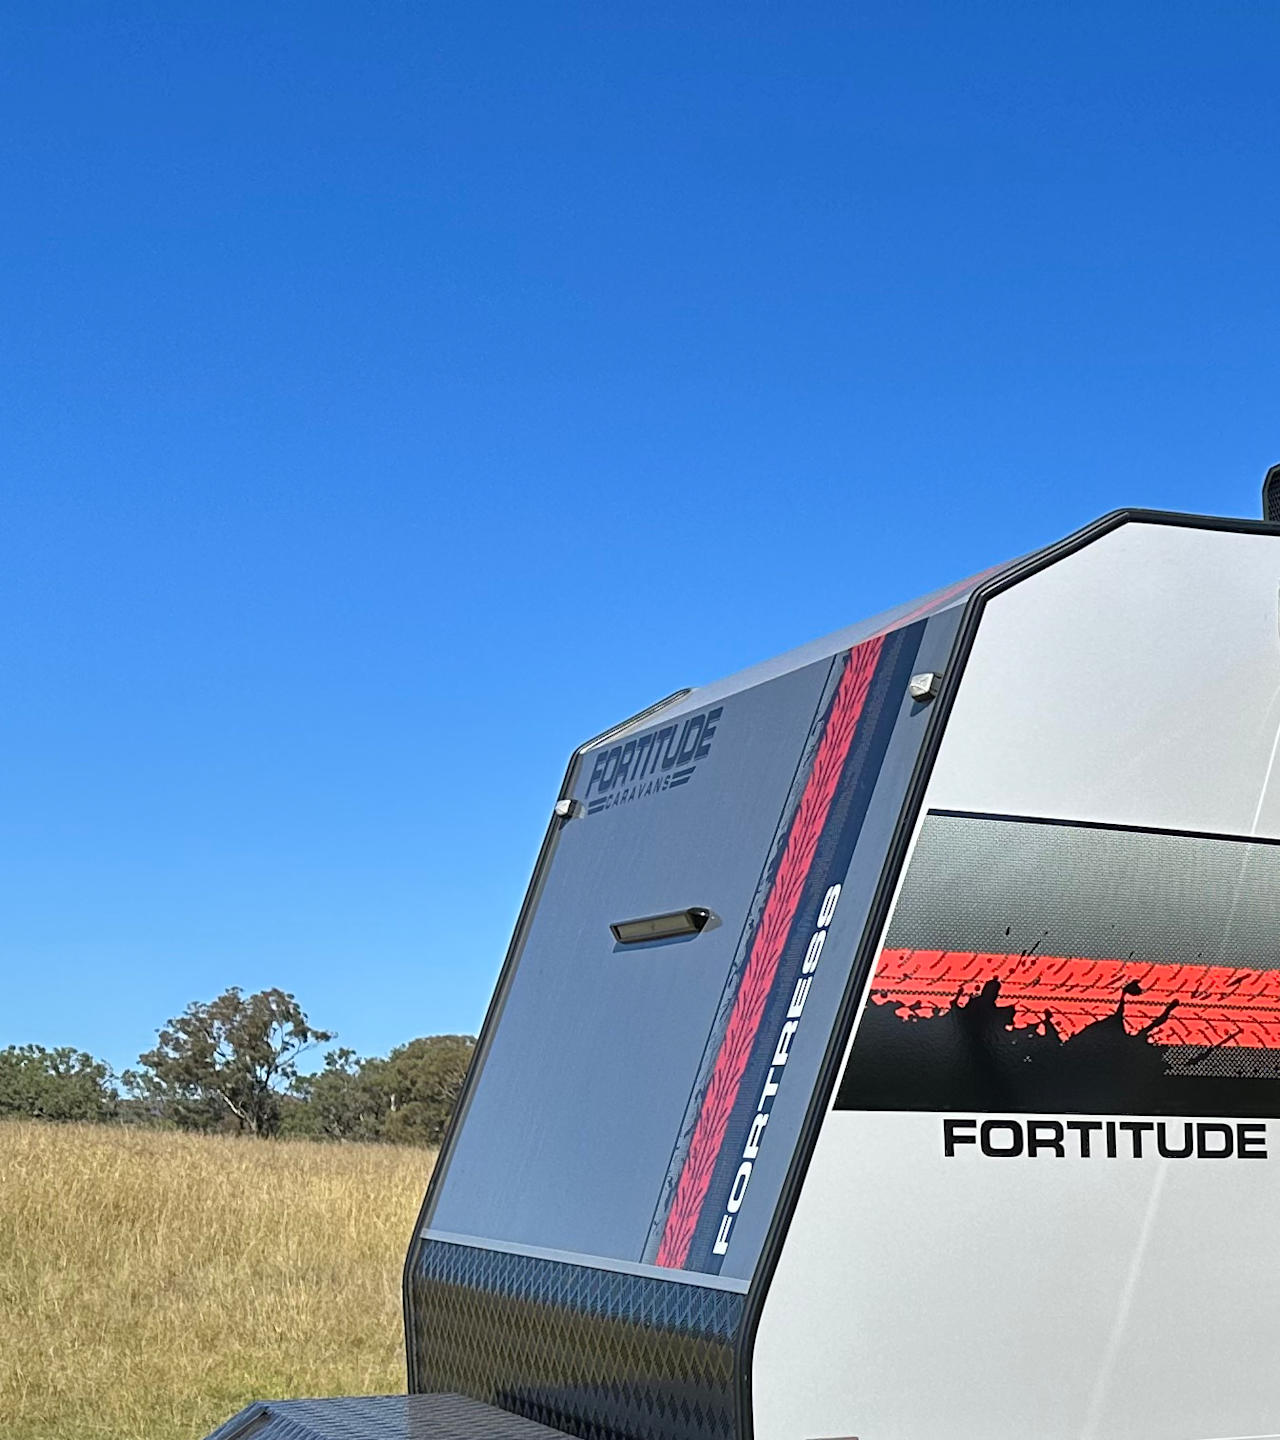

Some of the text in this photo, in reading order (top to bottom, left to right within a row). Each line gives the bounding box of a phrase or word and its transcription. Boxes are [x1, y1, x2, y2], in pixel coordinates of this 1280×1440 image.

[585, 706, 723, 799] FORTITUDE
[605, 774, 671, 810] CARAVANS
[712, 883, 842, 1256] FORTRESS
[943, 1119, 1268, 1160] FORTITUDE
